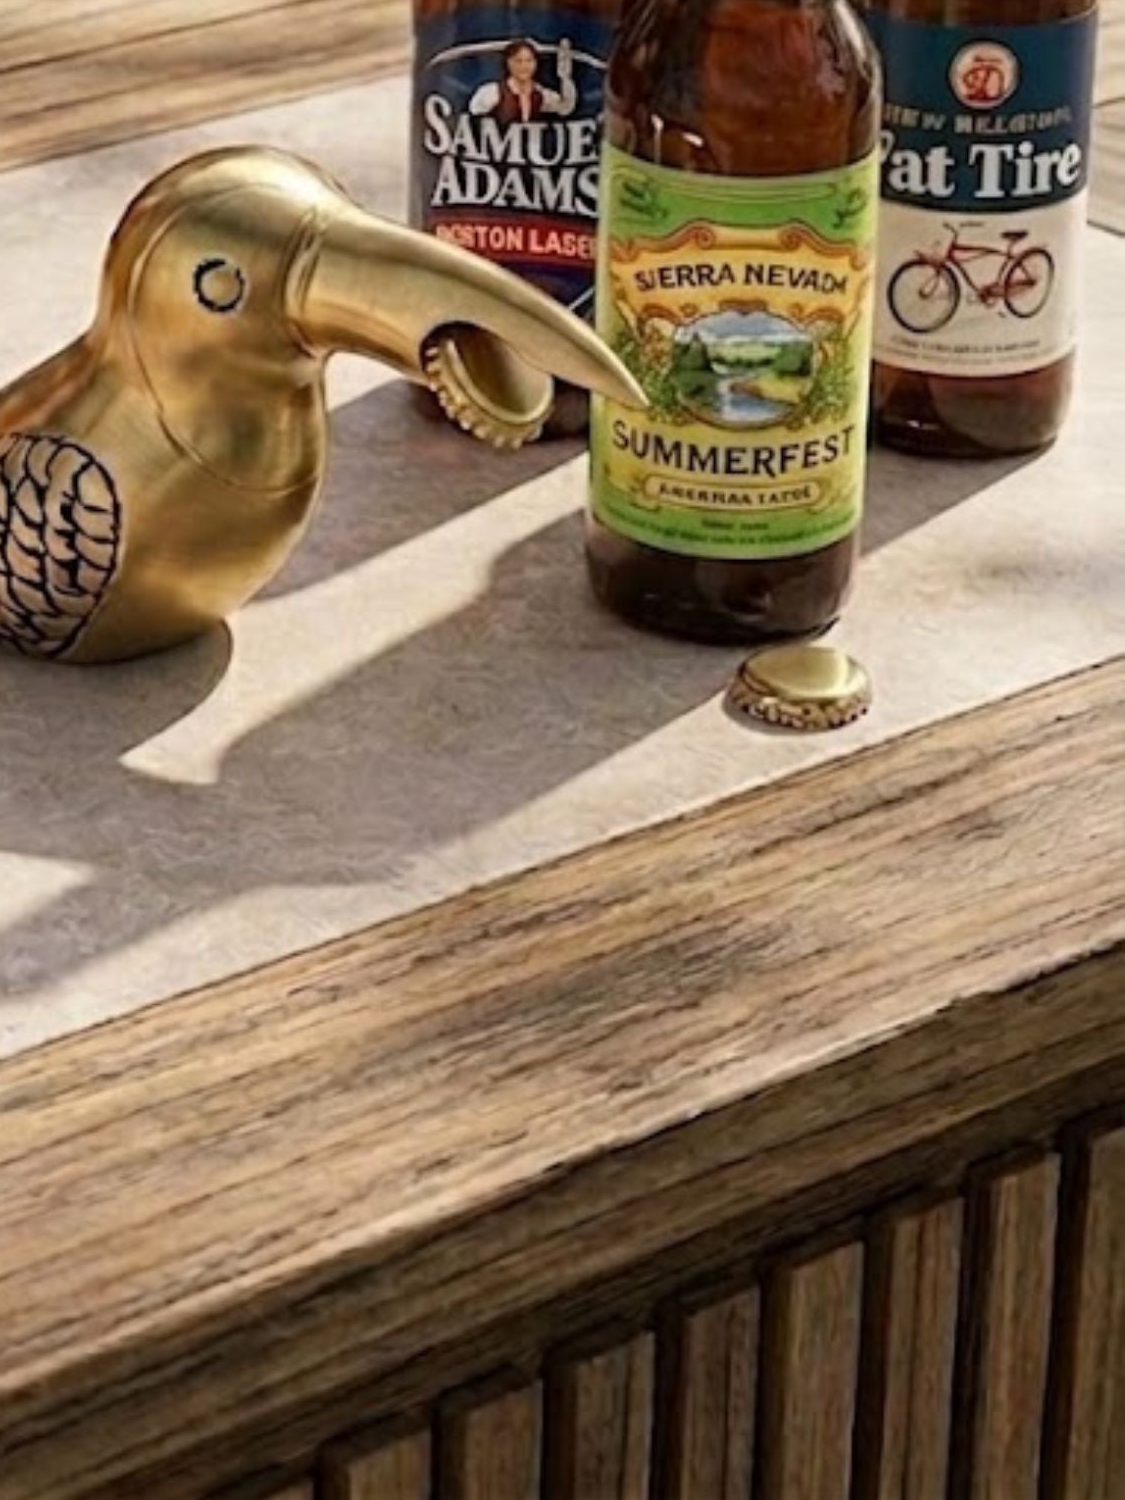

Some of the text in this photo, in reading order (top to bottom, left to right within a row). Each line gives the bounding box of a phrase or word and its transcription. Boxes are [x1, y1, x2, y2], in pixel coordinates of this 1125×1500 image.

[424, 94, 604, 167] SAMUE
[430, 155, 600, 218] ADAMS
[968, 140, 1082, 199] Tire
[634, 262, 735, 293] SIERRA
[612, 419, 855, 478] SUMMERFEST
